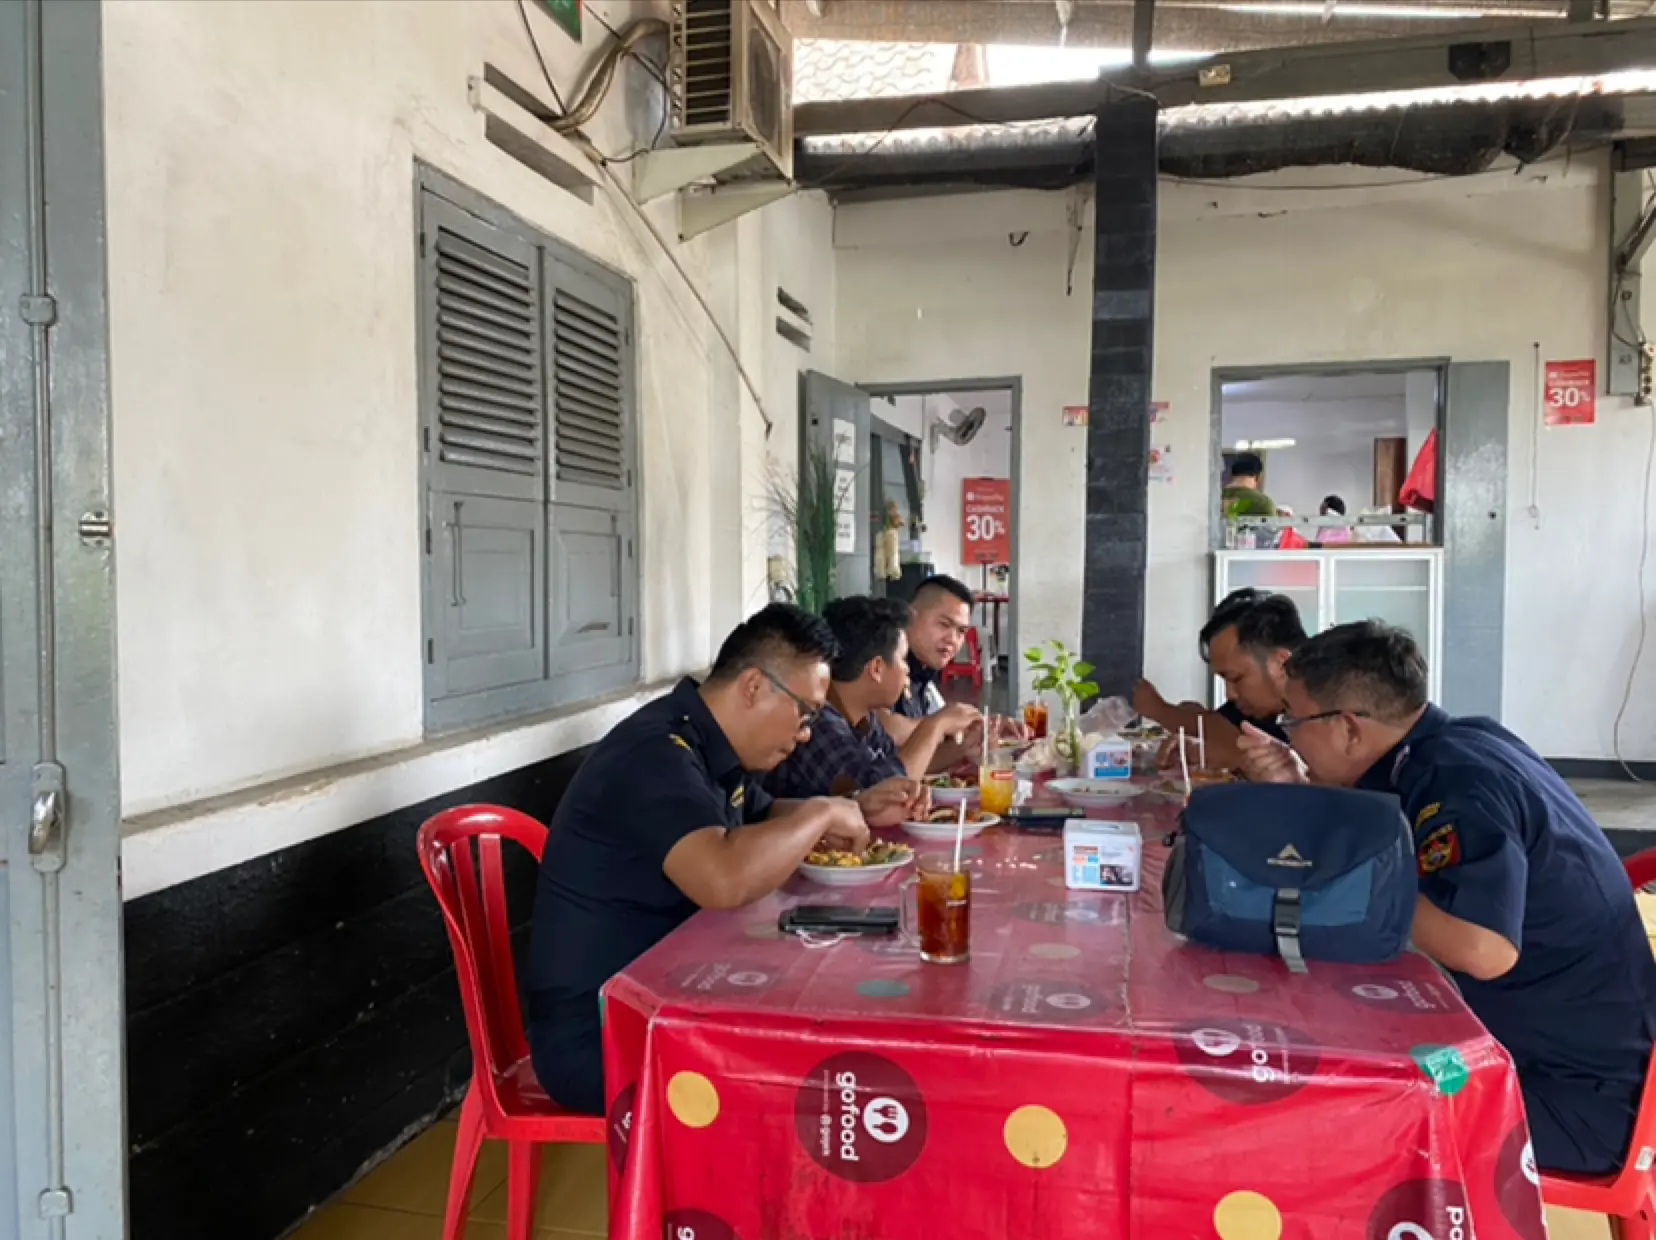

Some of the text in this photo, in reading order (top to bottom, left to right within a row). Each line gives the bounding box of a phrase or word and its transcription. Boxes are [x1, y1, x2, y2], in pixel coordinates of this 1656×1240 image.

[1549, 387, 1590, 407] 30%
[966, 514, 1005, 541] 30%
[835, 1071, 860, 1161] gofood
